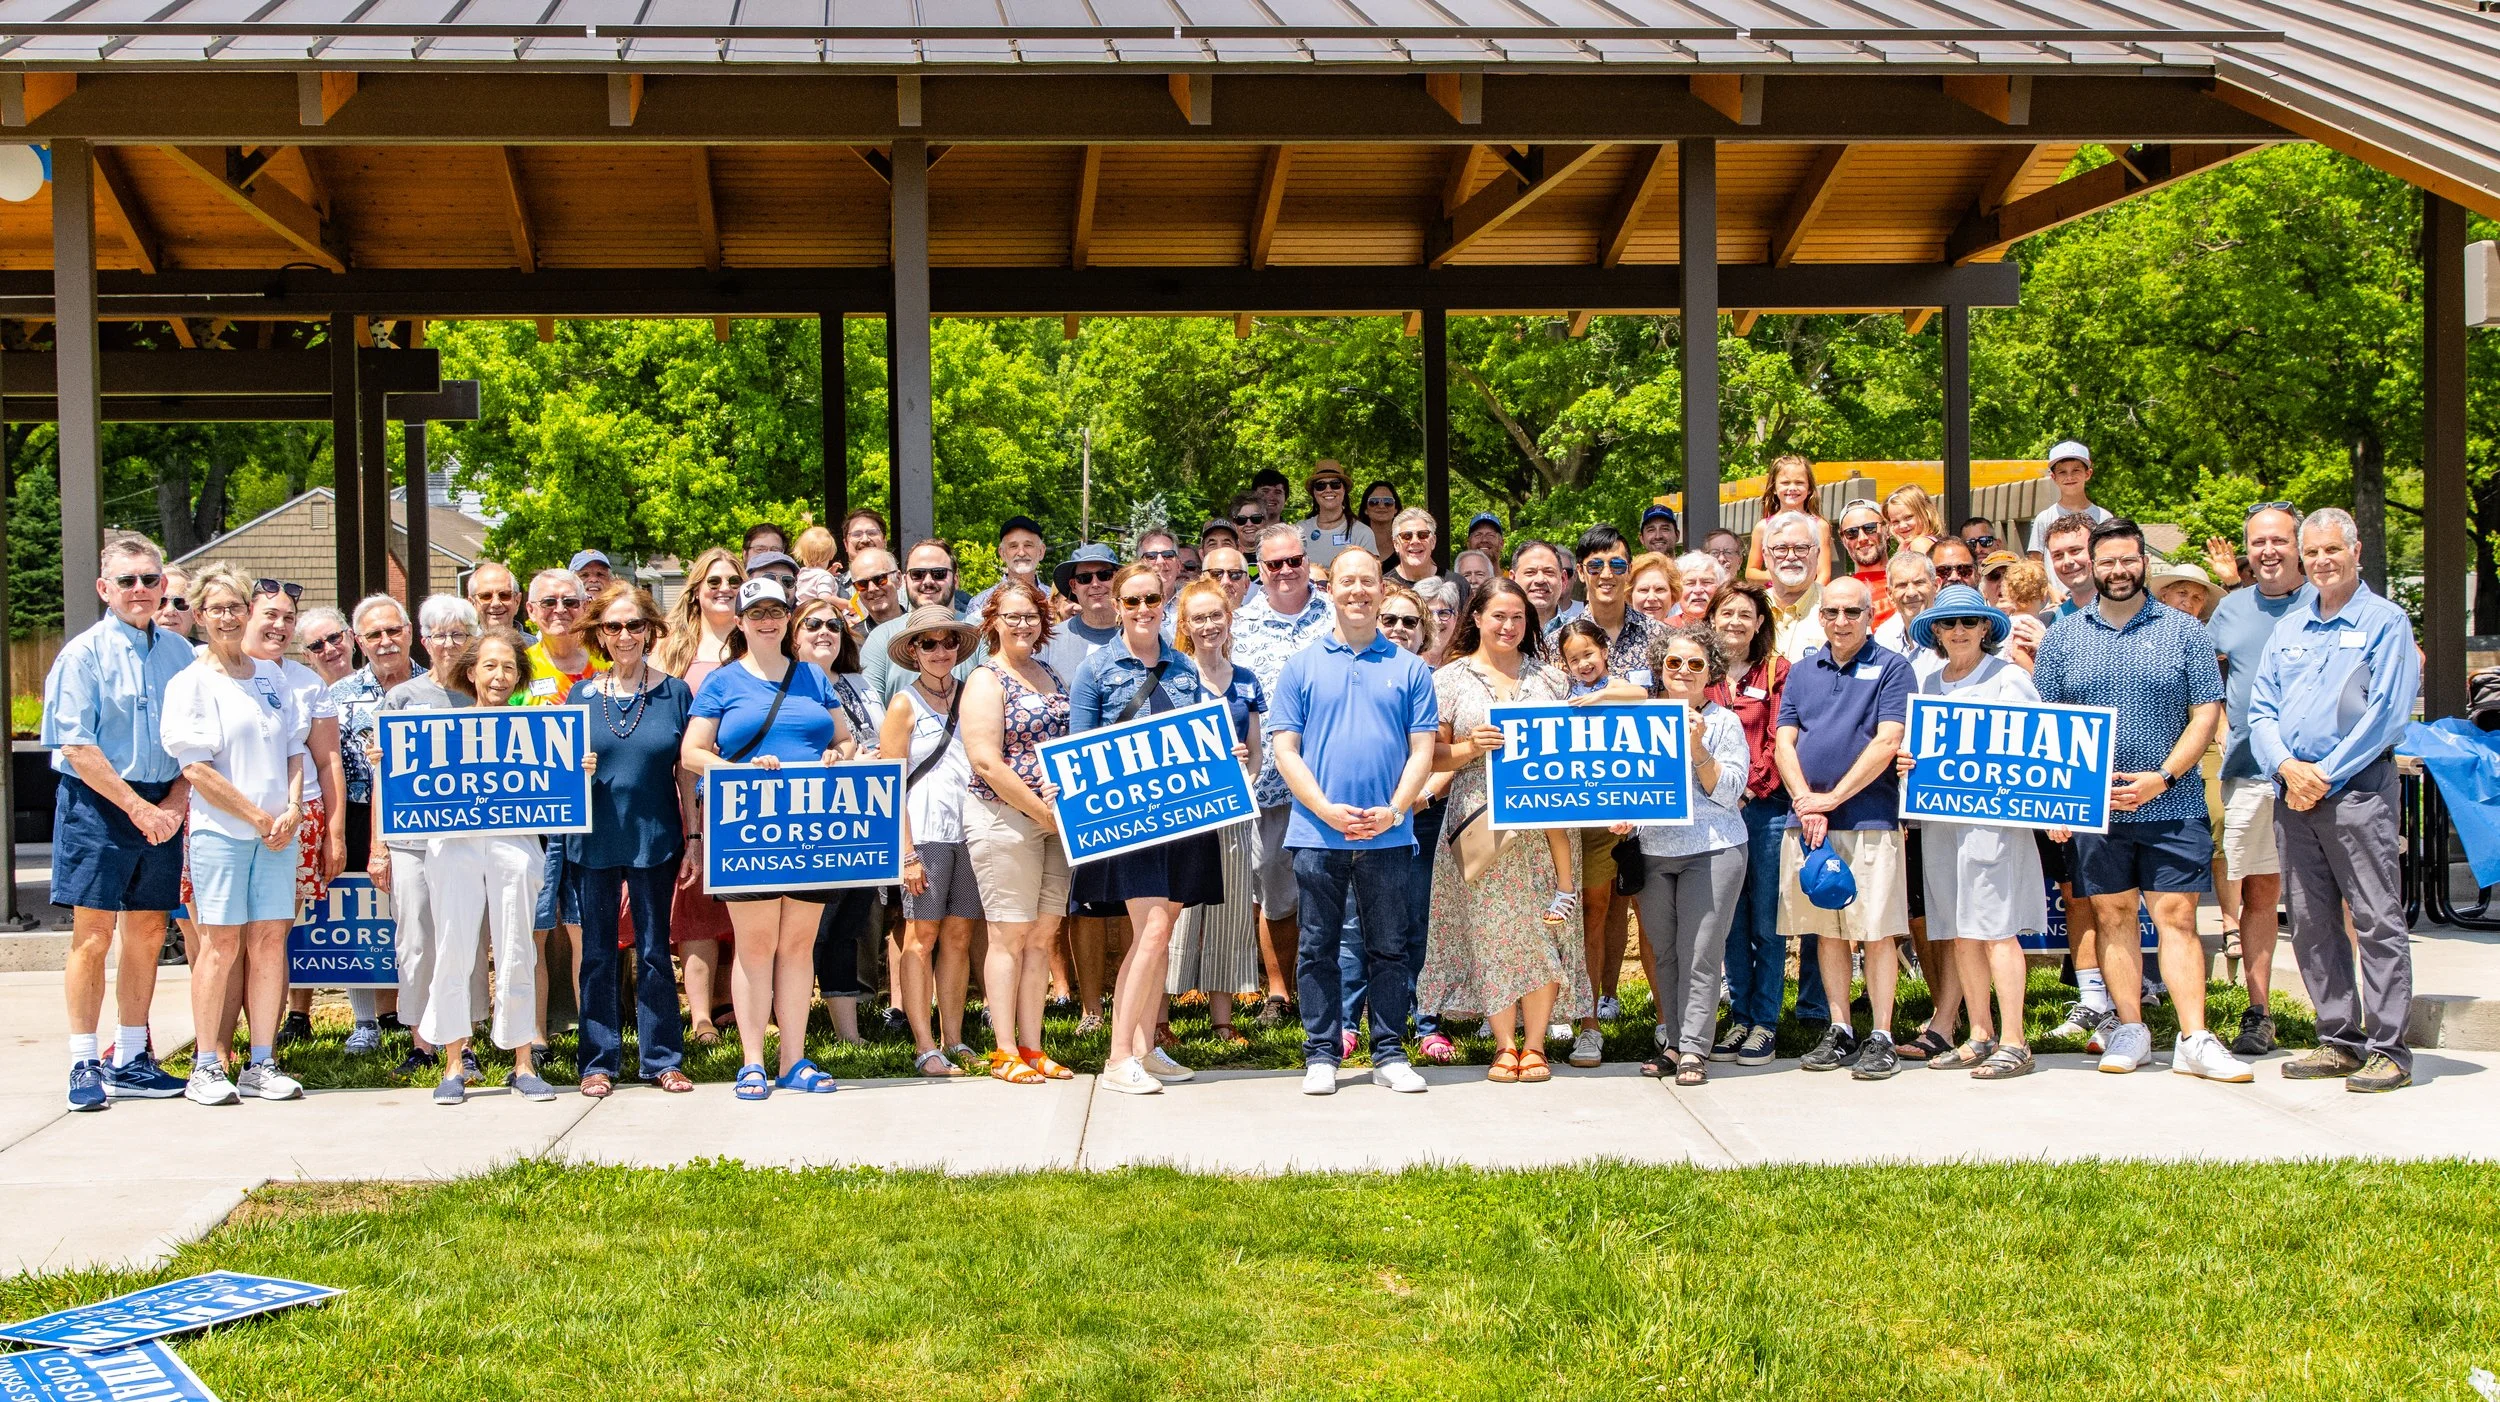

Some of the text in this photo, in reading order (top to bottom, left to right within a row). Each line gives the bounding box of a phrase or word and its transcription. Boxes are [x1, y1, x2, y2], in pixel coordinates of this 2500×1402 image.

[388, 716, 576, 778] ETHAN
[1500, 715, 1679, 763] ETHAN
[1917, 705, 2103, 773] ETHAN
[1051, 714, 1227, 800] ETHAN
[1522, 759, 1655, 781] CORSON
[413, 770, 550, 797] CORSON
[1584, 779, 1599, 788] for
[1938, 759, 2072, 790] CORSON
[475, 795, 489, 806] for
[719, 776, 896, 825] ETHAN
[1085, 766, 1211, 815] CORSON
[1505, 790, 1677, 809] KANSAS SENATE
[1996, 785, 2011, 796] for
[393, 804, 573, 829] KANSAS SENATE
[1147, 802, 1161, 814] for
[1915, 791, 2091, 822] KANSAS SENATE
[740, 820, 869, 843] CORSON
[1077, 794, 1241, 850] KANSAS SENATE
[801, 842, 815, 850] for
[722, 851, 889, 872] KANSAS SENATE
[293, 888, 392, 927] ETH
[310, 928, 391, 945] CORS
[293, 957, 375, 970] KANSAS
[126, 1278, 232, 1307] KANSAS
[58, 1283, 311, 1344] ETHAN
[70, 1286, 239, 1330] CORSON
[39, 1357, 102, 1402] CORSO
[63, 1343, 184, 1402] THA
